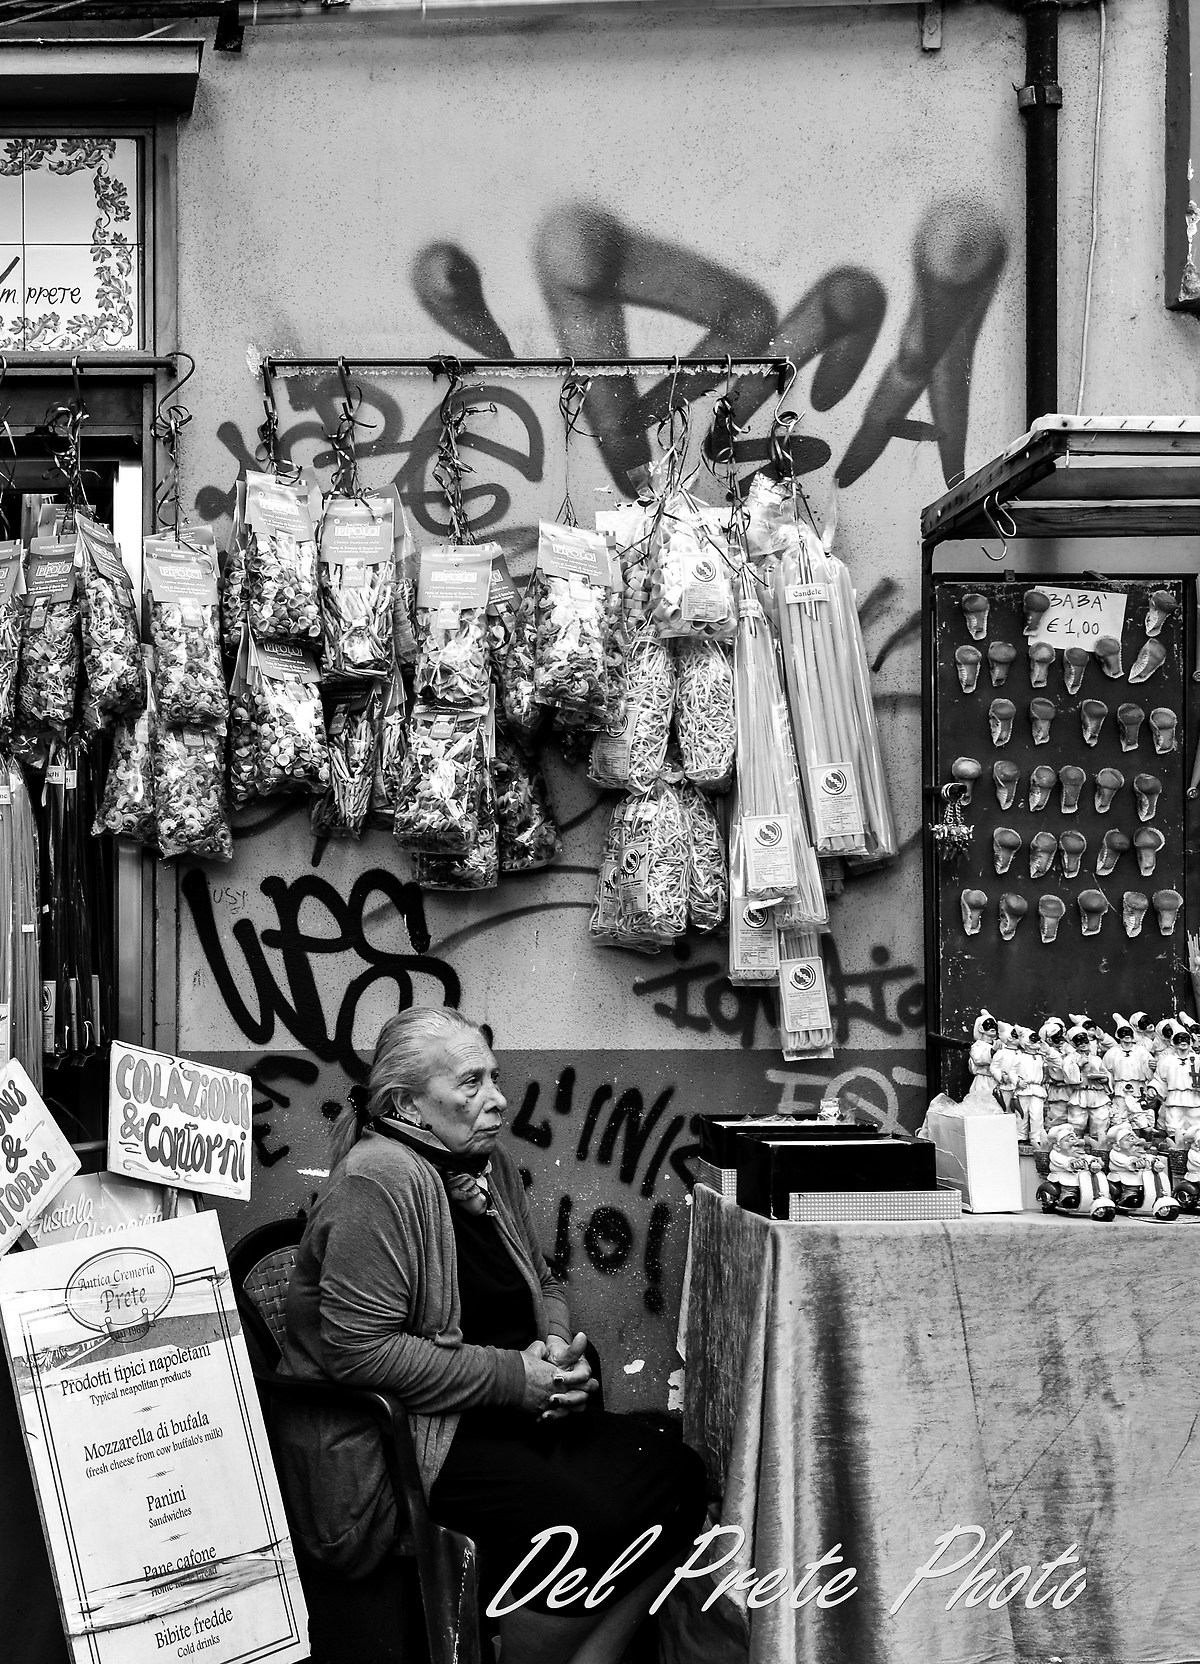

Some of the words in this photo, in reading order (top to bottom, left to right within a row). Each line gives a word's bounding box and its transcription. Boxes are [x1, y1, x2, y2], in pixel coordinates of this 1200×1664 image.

[793, 587, 822, 598] Candele
[1064, 618, 1100, 639] 1,00
[120, 1102, 145, 1142] &
[1, 1134, 28, 1173] &
[78, 1275, 111, 1292] Antica
[113, 1263, 156, 1283] Cremeria
[100, 1286, 147, 1313] Prete
[60, 1368, 112, 1397] Prodotti
[114, 1358, 146, 1383] tipici
[148, 1341, 212, 1372] napoletani
[89, 1389, 119, 1406] Typical
[120, 1378, 160, 1399] neapolitan
[161, 1368, 192, 1389] products
[84, 1428, 154, 1462] Mozzarella
[156, 1421, 170, 1440] di
[171, 1411, 210, 1436] bufala
[86, 1462, 109, 1479] (fresh
[110, 1456, 135, 1472] cheese
[136, 1451, 155, 1464] from
[156, 1445, 172, 1460] cow
[172, 1434, 204, 1453] buffalo's
[204, 1427, 224, 1442] milk)
[146, 1484, 187, 1512] Panini
[148, 1506, 192, 1529] Sandwiches
[143, 1561, 174, 1582] Pane
[176, 1546, 217, 1571] cafone
[154, 1620, 192, 1649] Bibite
[194, 1606, 234, 1635] fredde
[177, 1643, 197, 1659] Cold
[197, 1633, 221, 1652] drinks
